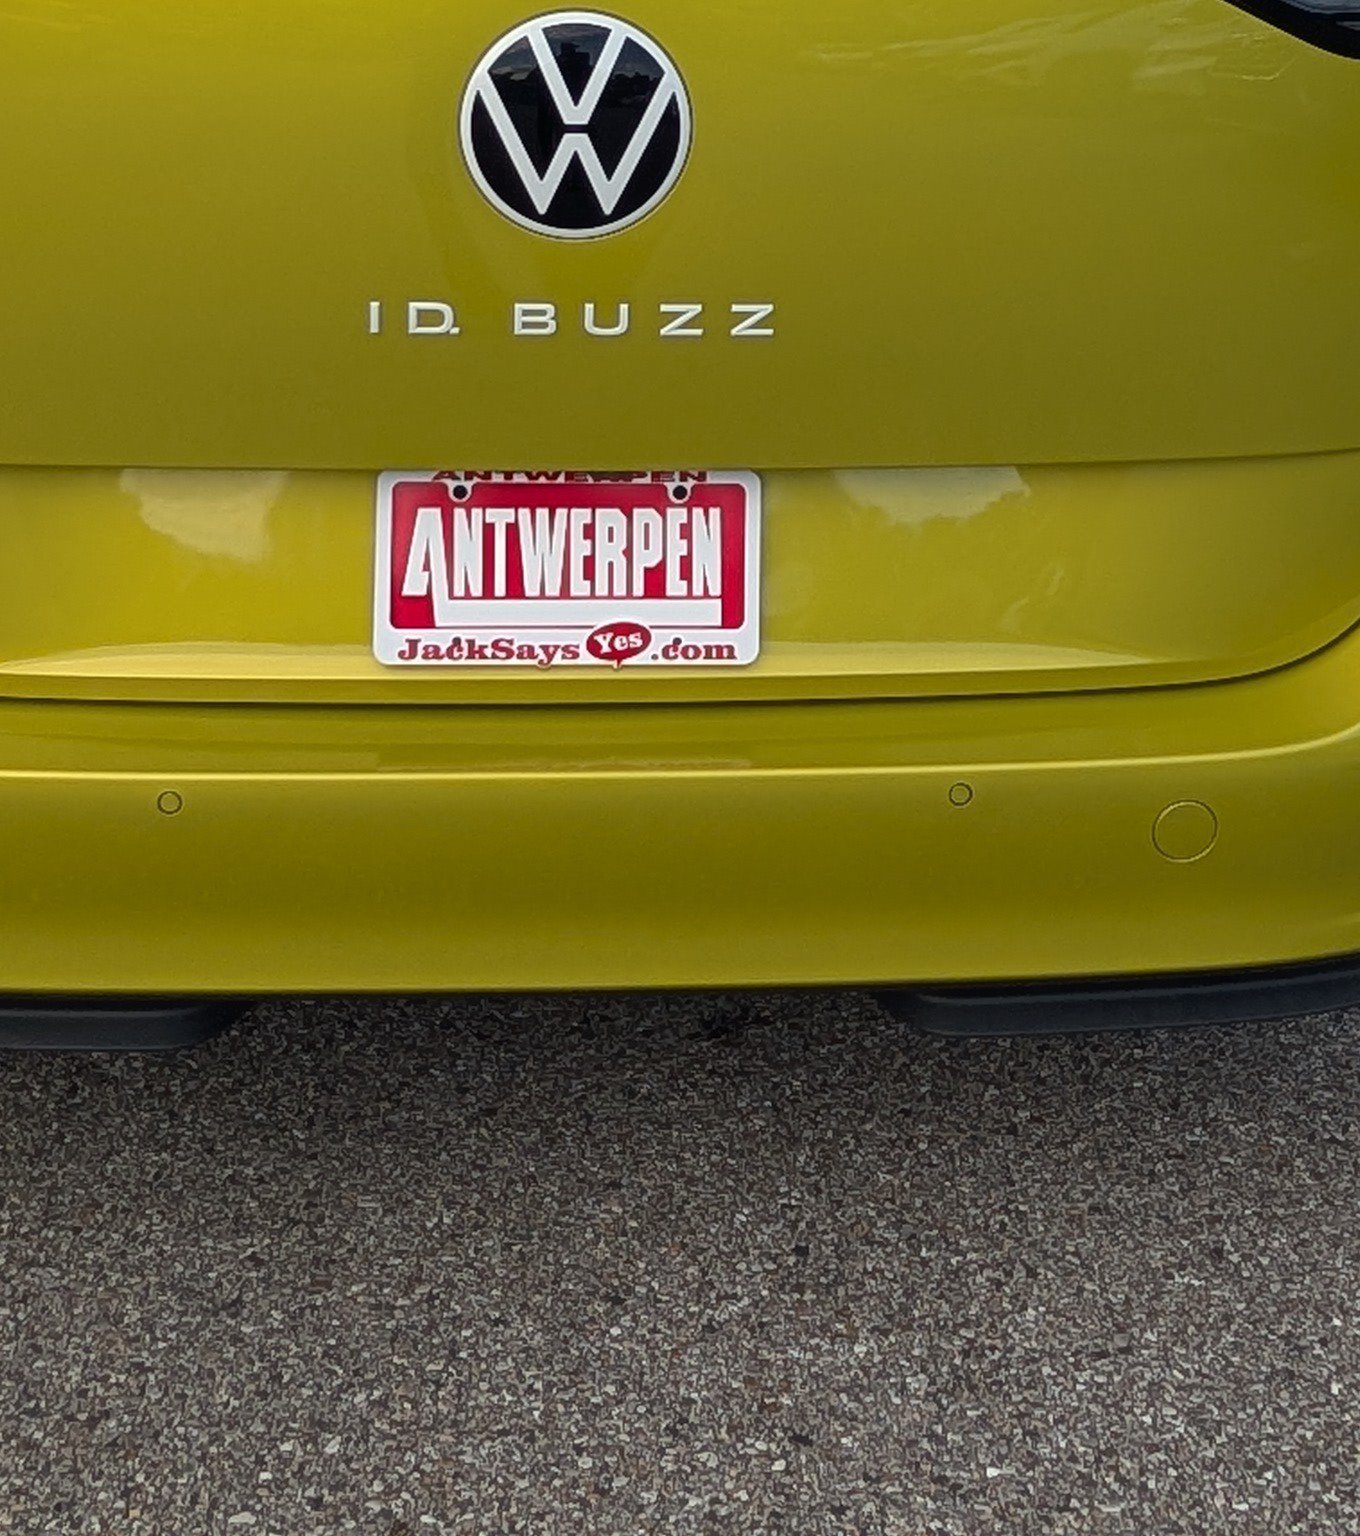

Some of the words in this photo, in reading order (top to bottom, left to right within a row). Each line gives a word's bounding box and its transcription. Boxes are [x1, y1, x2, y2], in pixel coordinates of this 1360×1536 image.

[513, 302, 775, 337] BUZZ
[401, 507, 722, 596] ANTWERPEN
[398, 638, 581, 665] JackSays
[593, 632, 643, 654] Yes
